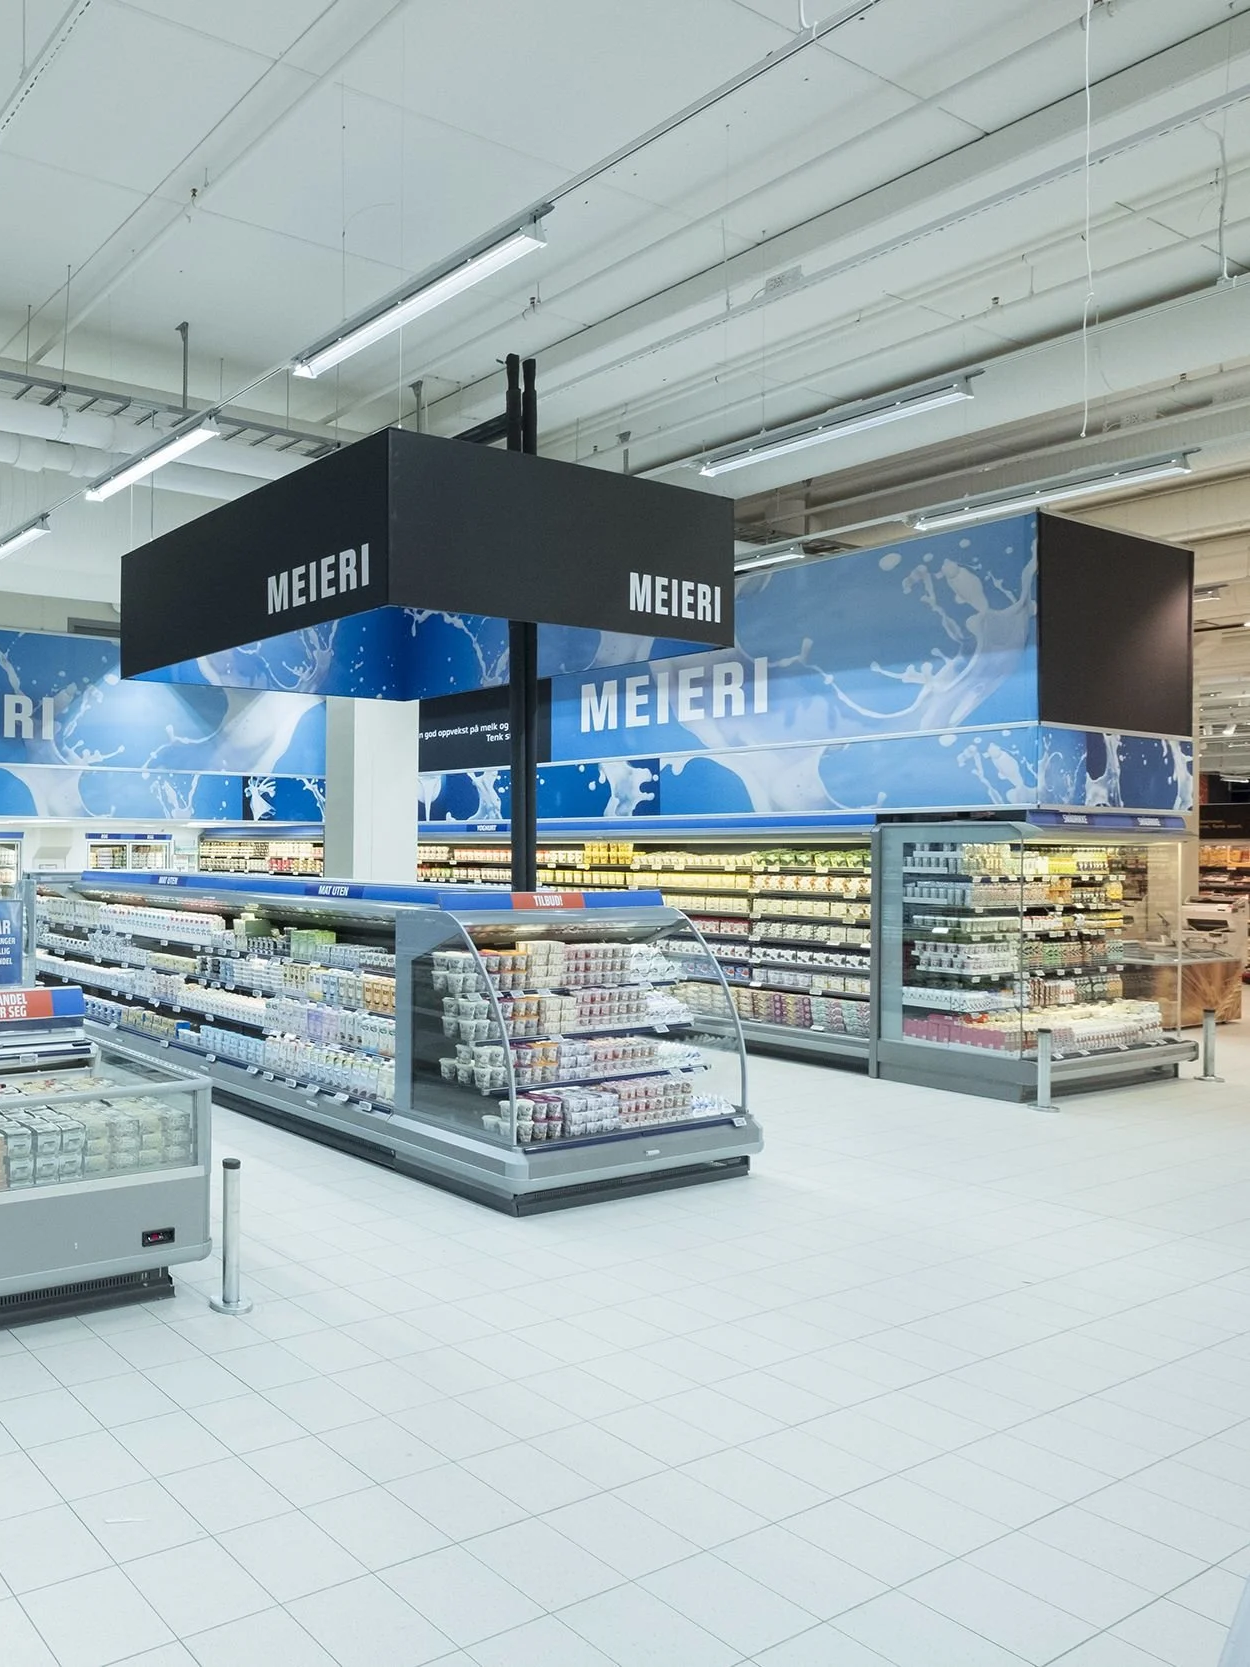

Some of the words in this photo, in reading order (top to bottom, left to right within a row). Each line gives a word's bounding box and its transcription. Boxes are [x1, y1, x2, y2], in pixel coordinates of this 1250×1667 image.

[268, 543, 369, 615] MEIERI
[629, 572, 721, 623] MEIERI
[580, 657, 768, 733] MEIERI
[424, 729, 437, 741] god
[437, 726, 469, 739] oppvekst
[469, 724, 479, 736] på
[480, 721, 498, 733] melk
[499, 721, 510, 733] og
[486, 732, 504, 742] Tenk
[158, 875, 167, 885] MAT
[317, 885, 331, 895] MAT
[332, 886, 349, 896] UTEN
[533, 895, 563, 907] TILBUD!
[8, 1005, 27, 1018] SEG
